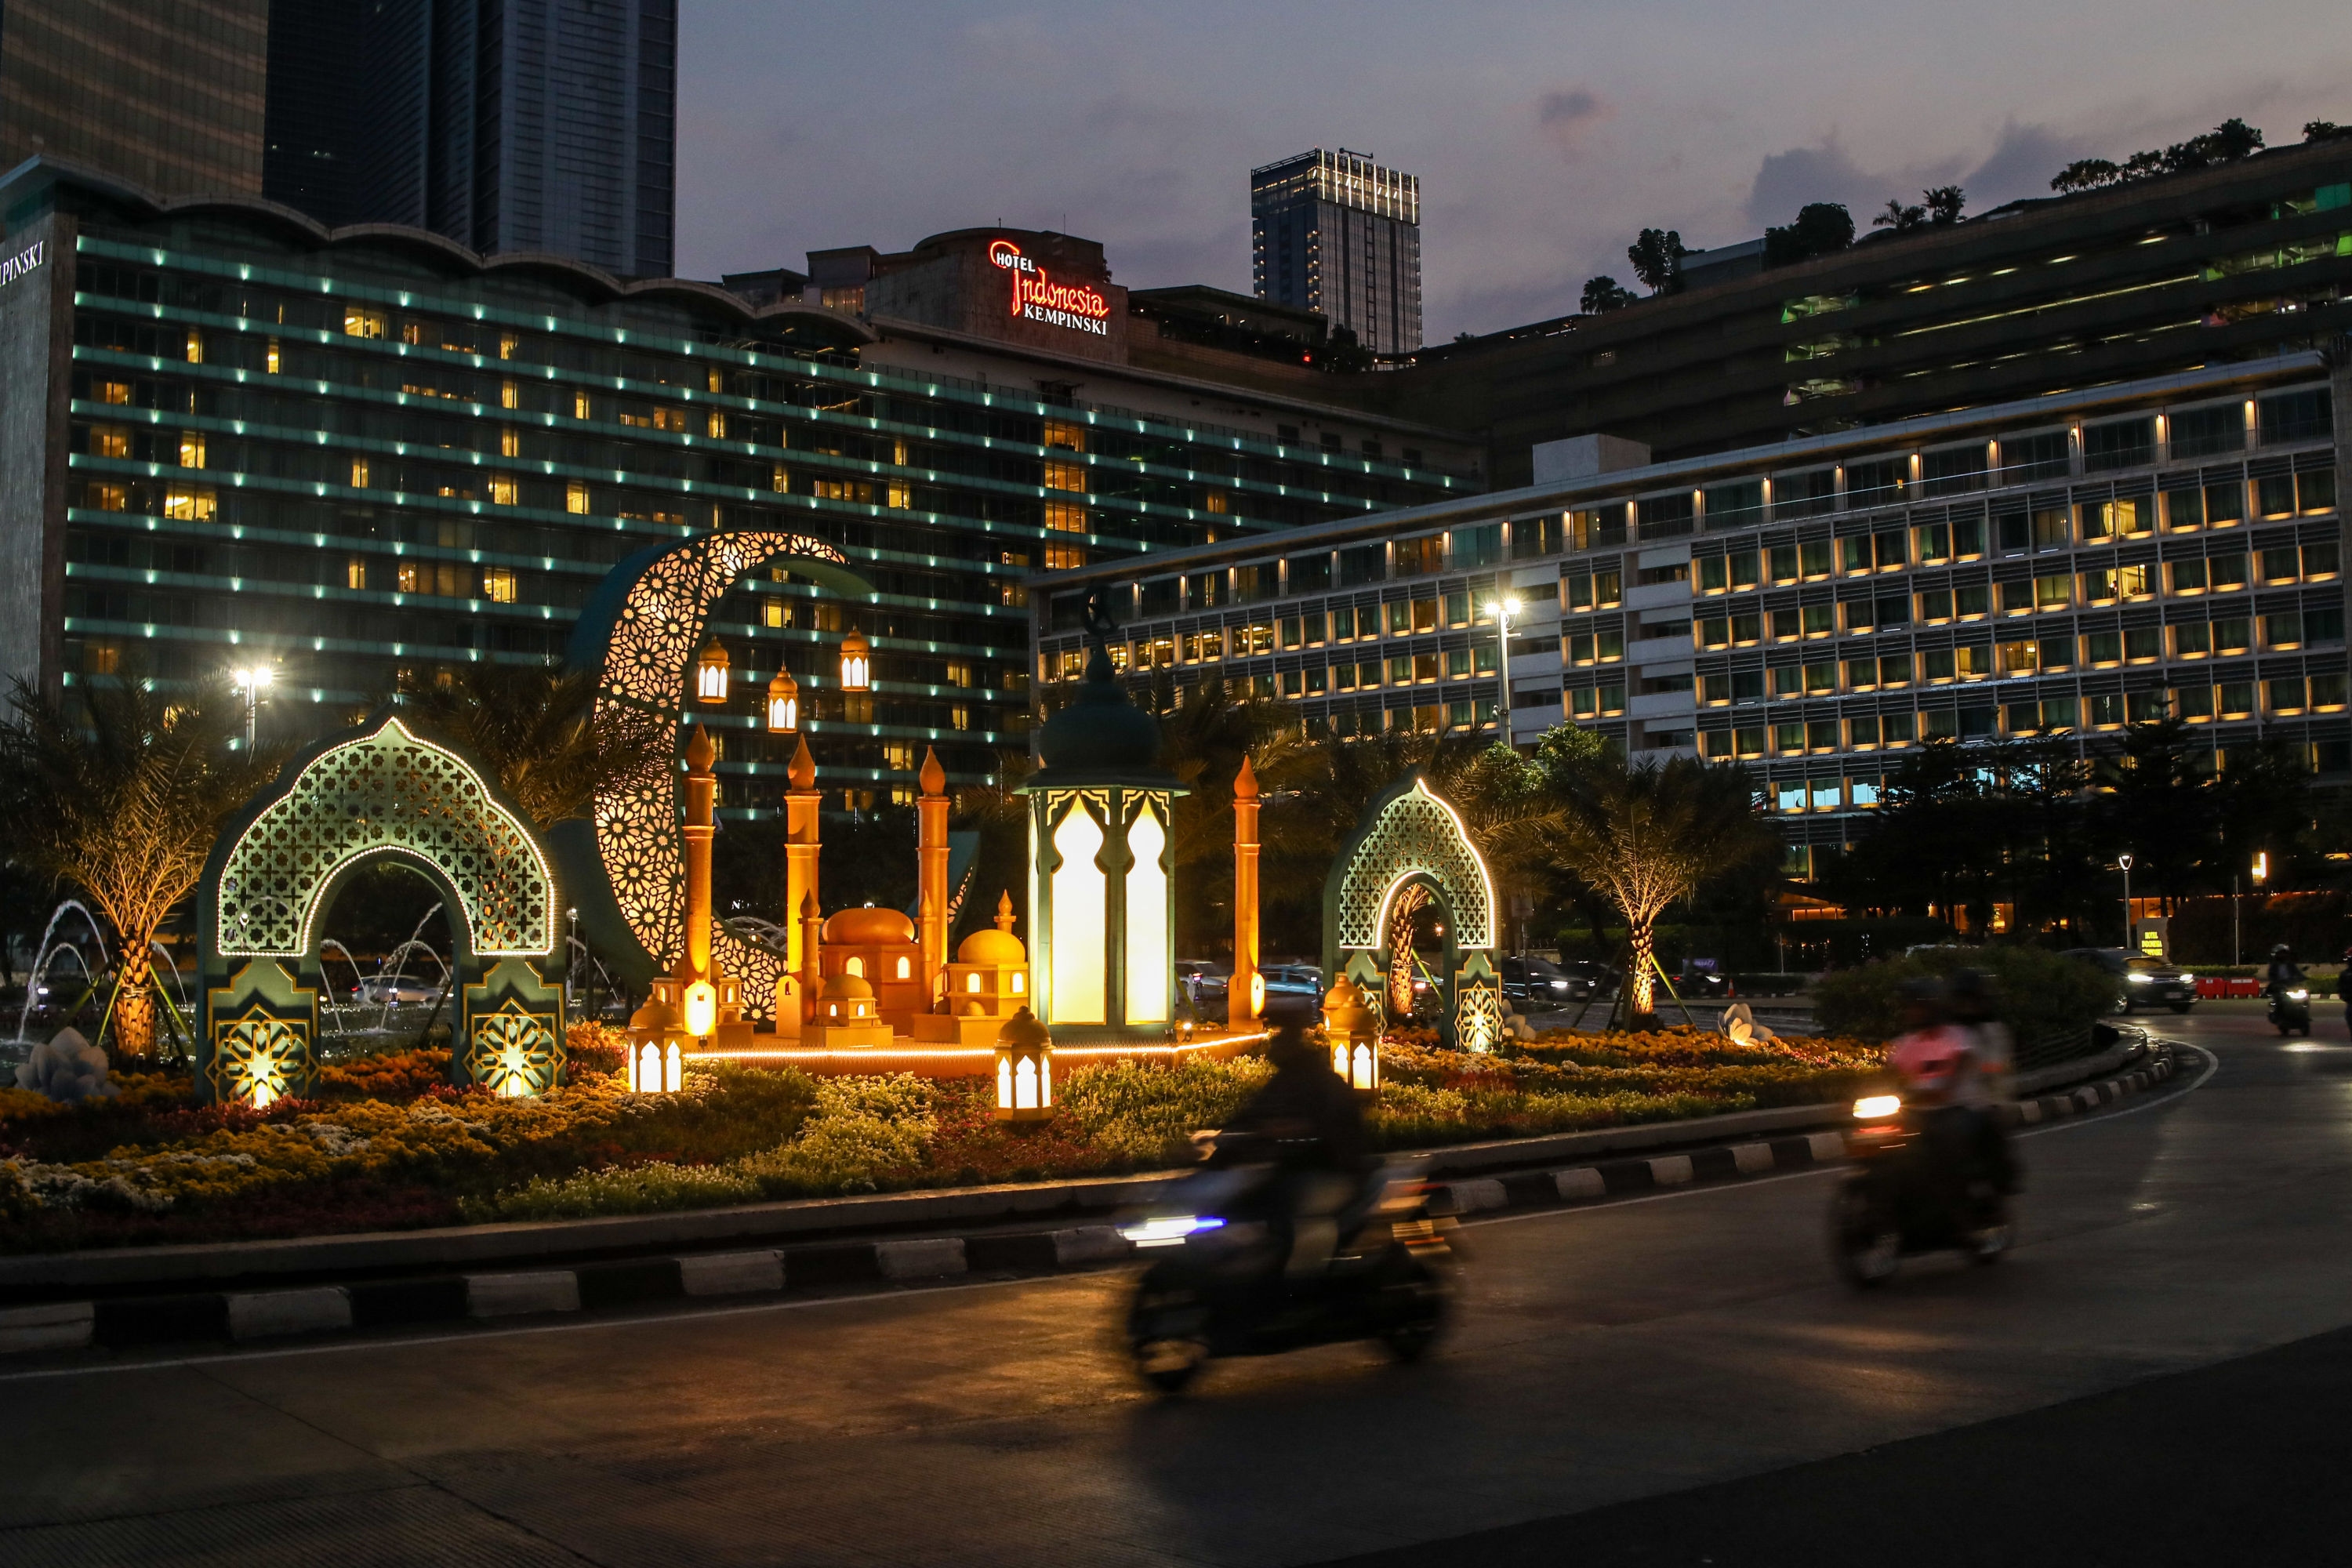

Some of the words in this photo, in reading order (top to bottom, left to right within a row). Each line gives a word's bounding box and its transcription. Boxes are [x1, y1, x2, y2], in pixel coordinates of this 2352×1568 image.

[0, 240, 44, 287] PINSKI
[989, 239, 1109, 318] Indonesia
[996, 252, 1036, 272] HOTEL
[1024, 303, 1107, 336] KEMPINSKI
